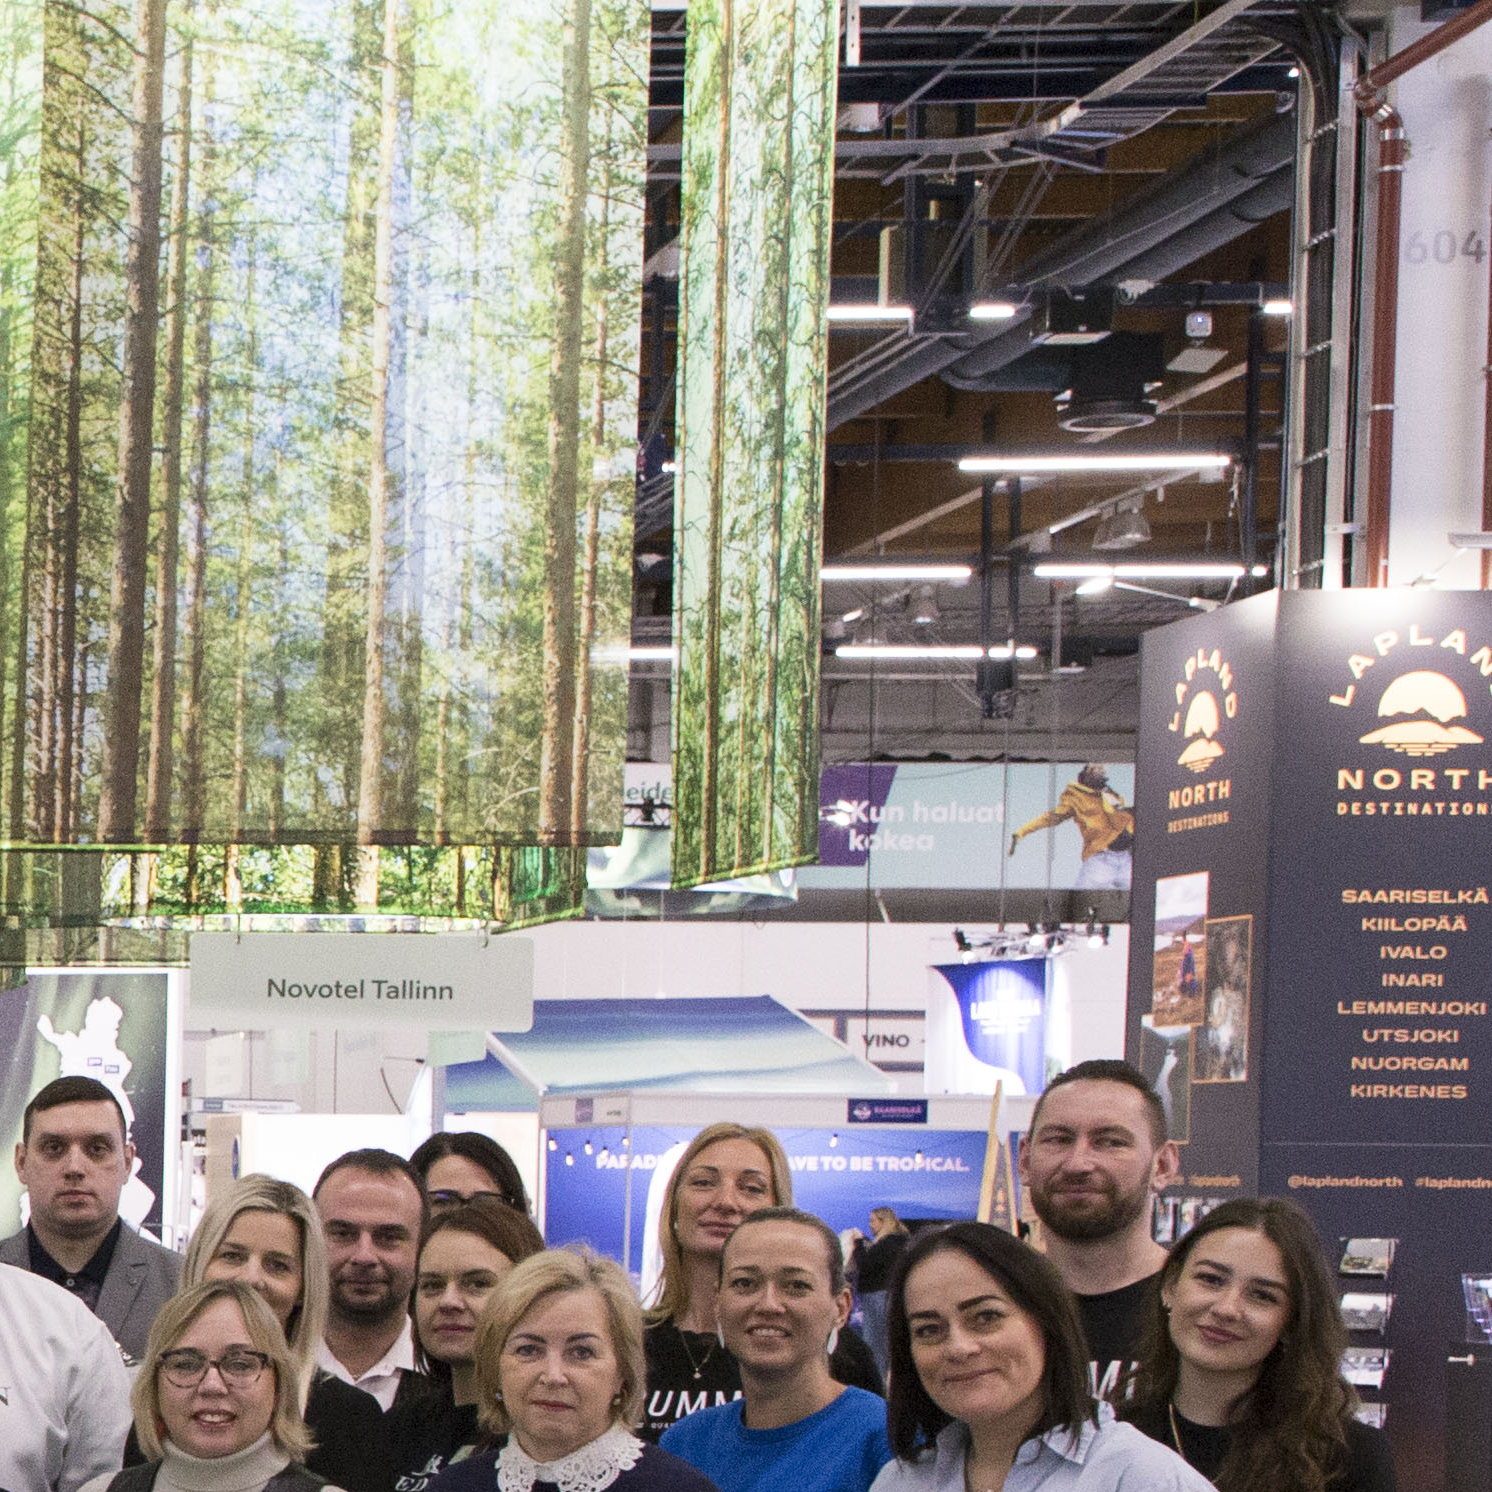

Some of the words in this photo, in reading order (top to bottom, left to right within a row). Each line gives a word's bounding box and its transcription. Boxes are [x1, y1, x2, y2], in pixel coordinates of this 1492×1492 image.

[1404, 229, 1488, 264] 604
[1329, 623, 1492, 706] LAPLAN
[1168, 648, 1237, 731] LAPLAND
[1169, 779, 1231, 810] NORTH
[851, 800, 905, 825] Kun
[913, 799, 1005, 825] haluat
[1337, 802, 1492, 816] DESTINATION
[1168, 811, 1230, 834] DESTINATIONS
[849, 828, 934, 851] kokea
[1341, 887, 1490, 904] SAARISELKÄ
[1361, 914, 1468, 932] KIILOPÄÄ
[1380, 945, 1448, 960] IVALO
[1382, 973, 1444, 987] INARI
[266, 979, 365, 999] Novotel
[371, 979, 454, 1000] Tallinn
[1337, 1001, 1487, 1015] LEMMENJOKI
[862, 1034, 910, 1047] VINO
[1362, 1029, 1460, 1043] UTSJOKI
[1351, 1056, 1470, 1071] NUORGAM
[1350, 1084, 1468, 1098] KIRKENES
[820, 1156, 847, 1171] TO
[850, 1156, 873, 1171] BE
[877, 1156, 970, 1172] TROPICAL.
[1287, 1174, 1403, 1189] @laplandnorth
